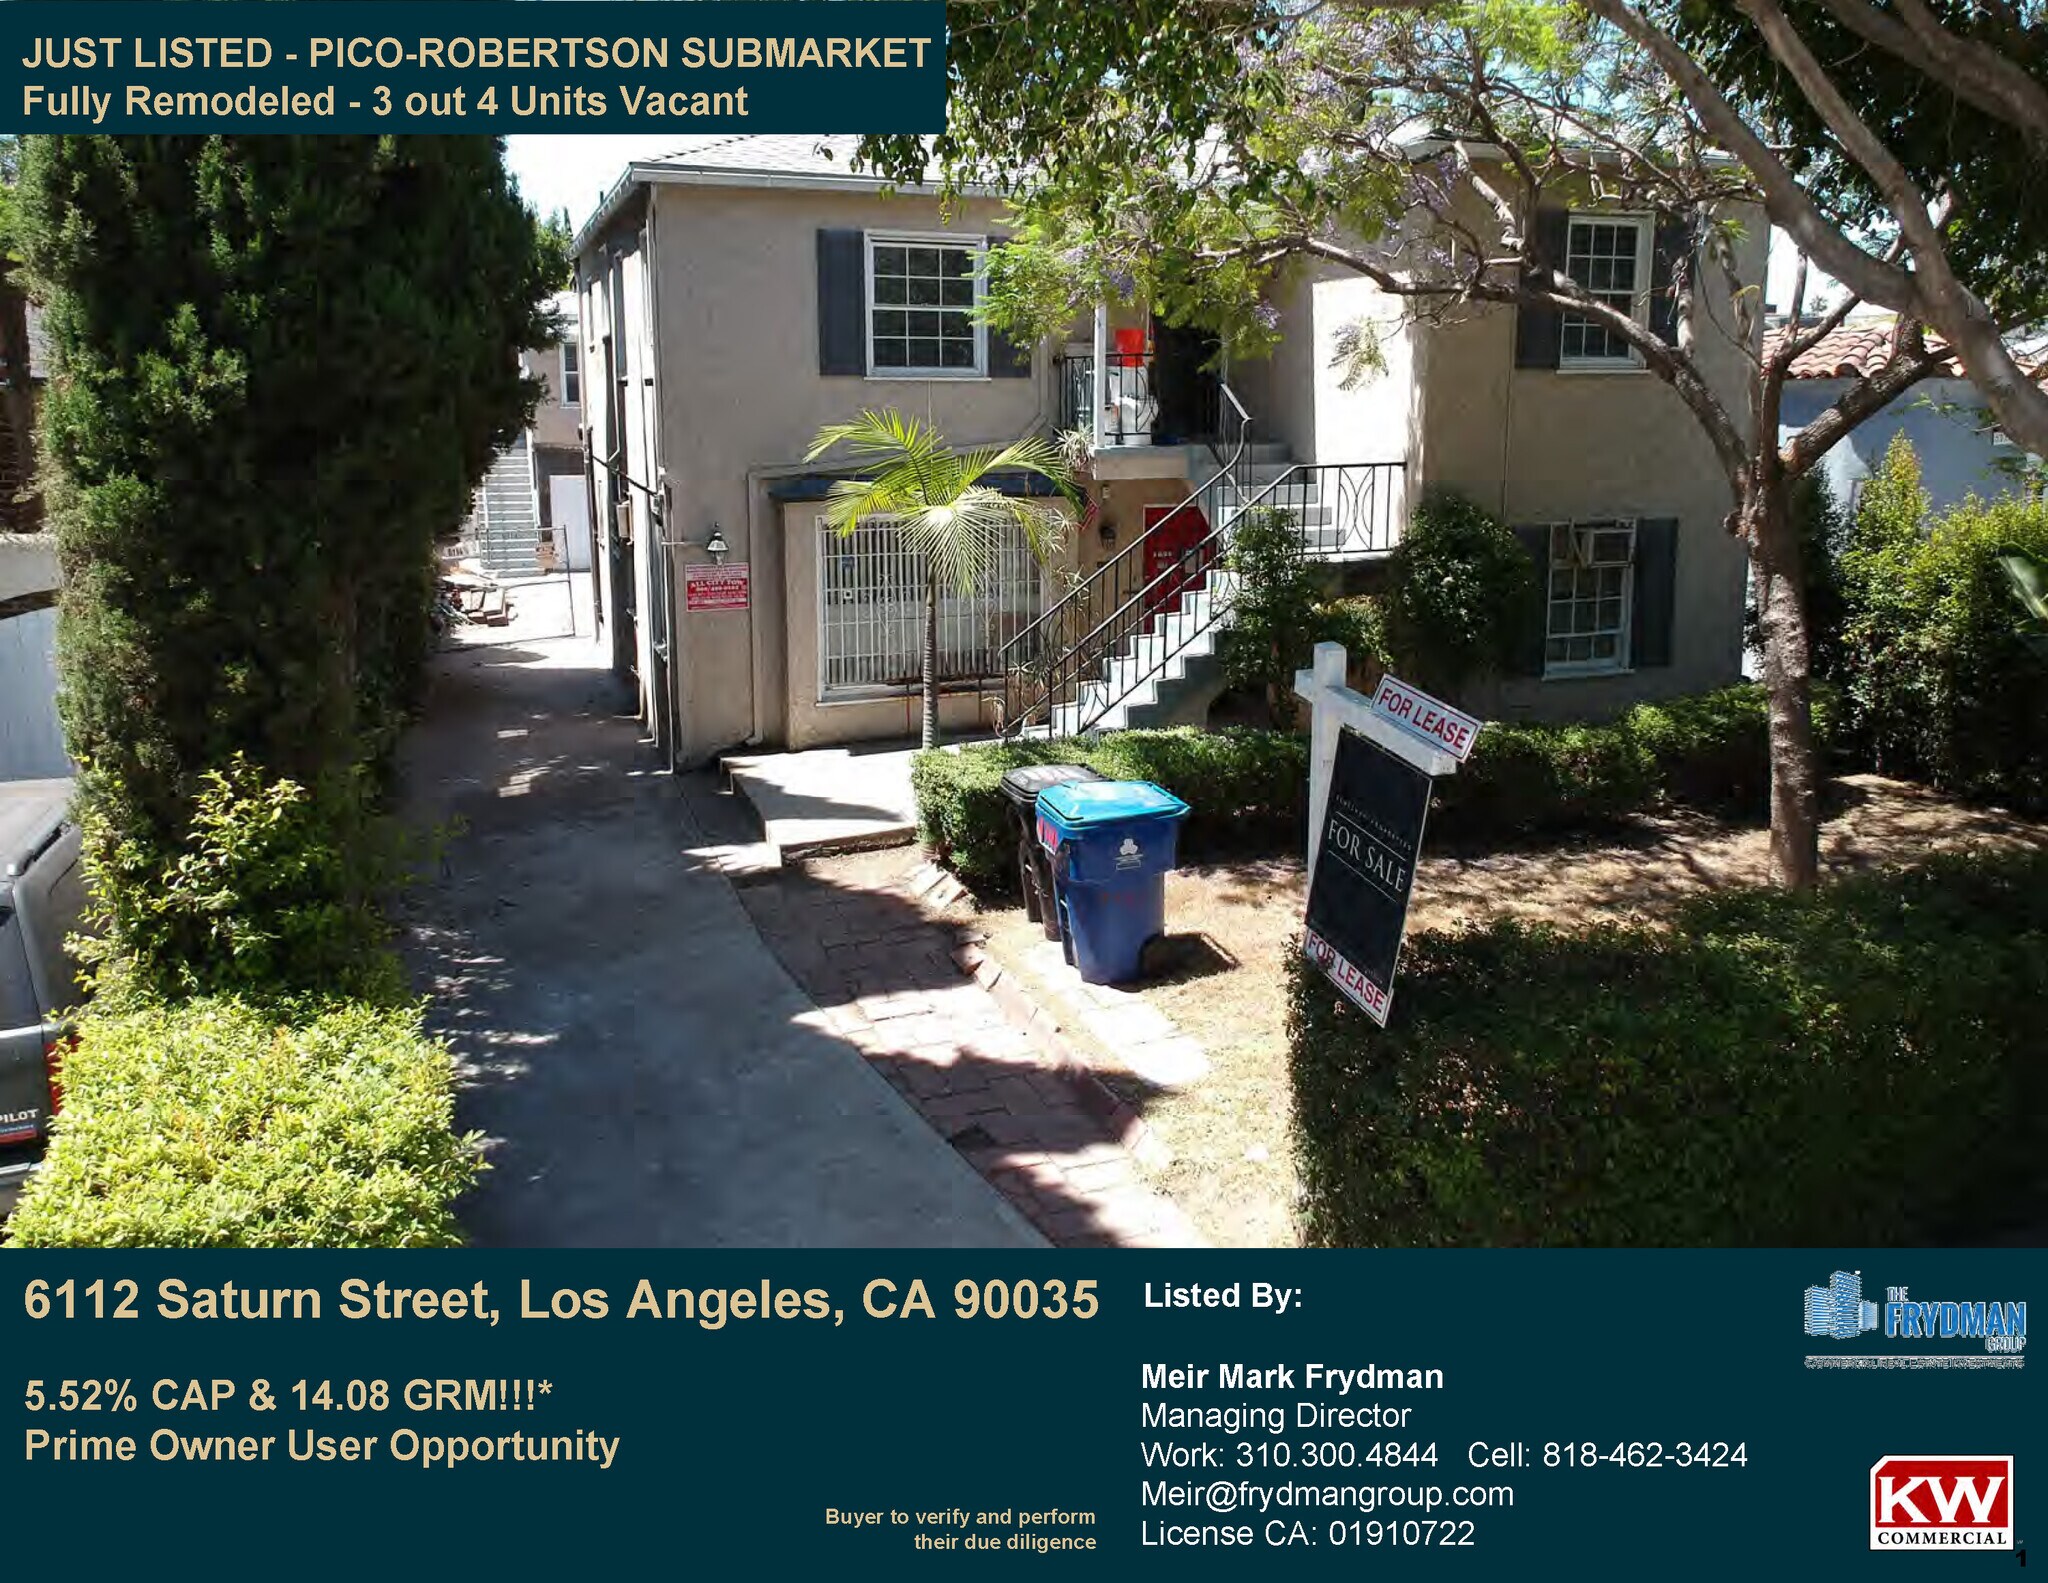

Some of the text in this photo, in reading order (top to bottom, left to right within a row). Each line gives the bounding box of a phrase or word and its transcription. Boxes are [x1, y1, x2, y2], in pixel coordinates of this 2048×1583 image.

[1379, 687, 1470, 750] FOR LEASE
[1328, 819, 1360, 860] FOR
[1364, 846, 1406, 892] SALE
[1308, 932, 1385, 1013] FOR LEASE
